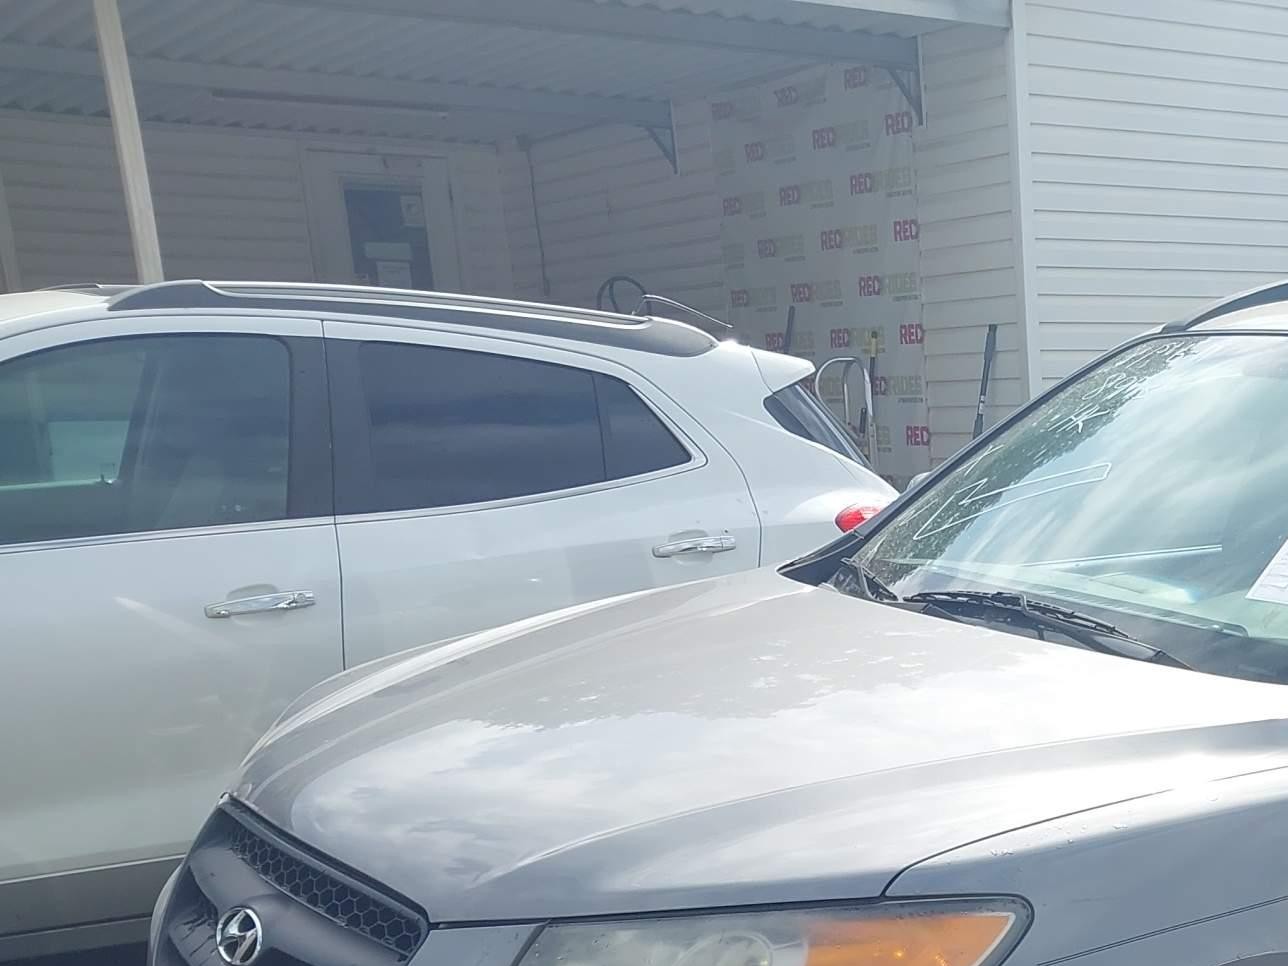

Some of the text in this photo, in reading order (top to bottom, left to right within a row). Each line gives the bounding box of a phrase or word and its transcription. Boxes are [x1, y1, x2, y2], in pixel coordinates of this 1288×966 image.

[884, 111, 913, 136] RED
[893, 219, 920, 242] RED
[899, 323, 925, 345] RED
[906, 426, 929, 447] RED
